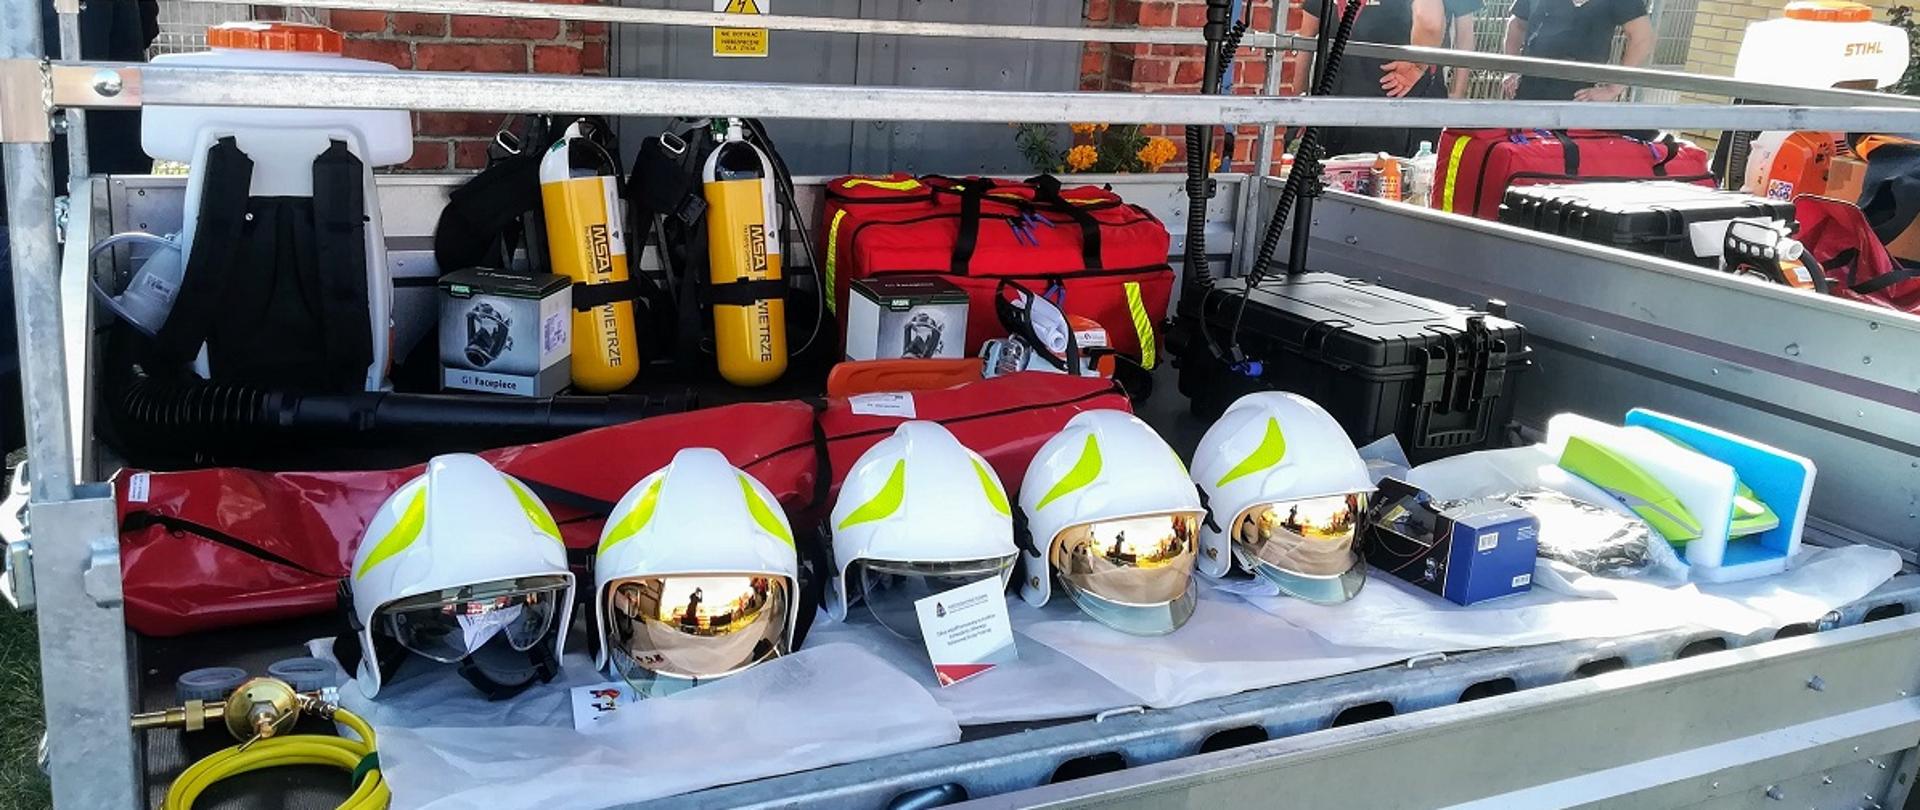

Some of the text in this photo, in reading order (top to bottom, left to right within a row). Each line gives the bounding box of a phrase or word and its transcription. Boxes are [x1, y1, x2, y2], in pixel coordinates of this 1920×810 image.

[1844, 42, 1883, 57] STIHL
[592, 225, 612, 273] MSA
[751, 225, 767, 270] MSA
[474, 377, 517, 390] Facepiece
